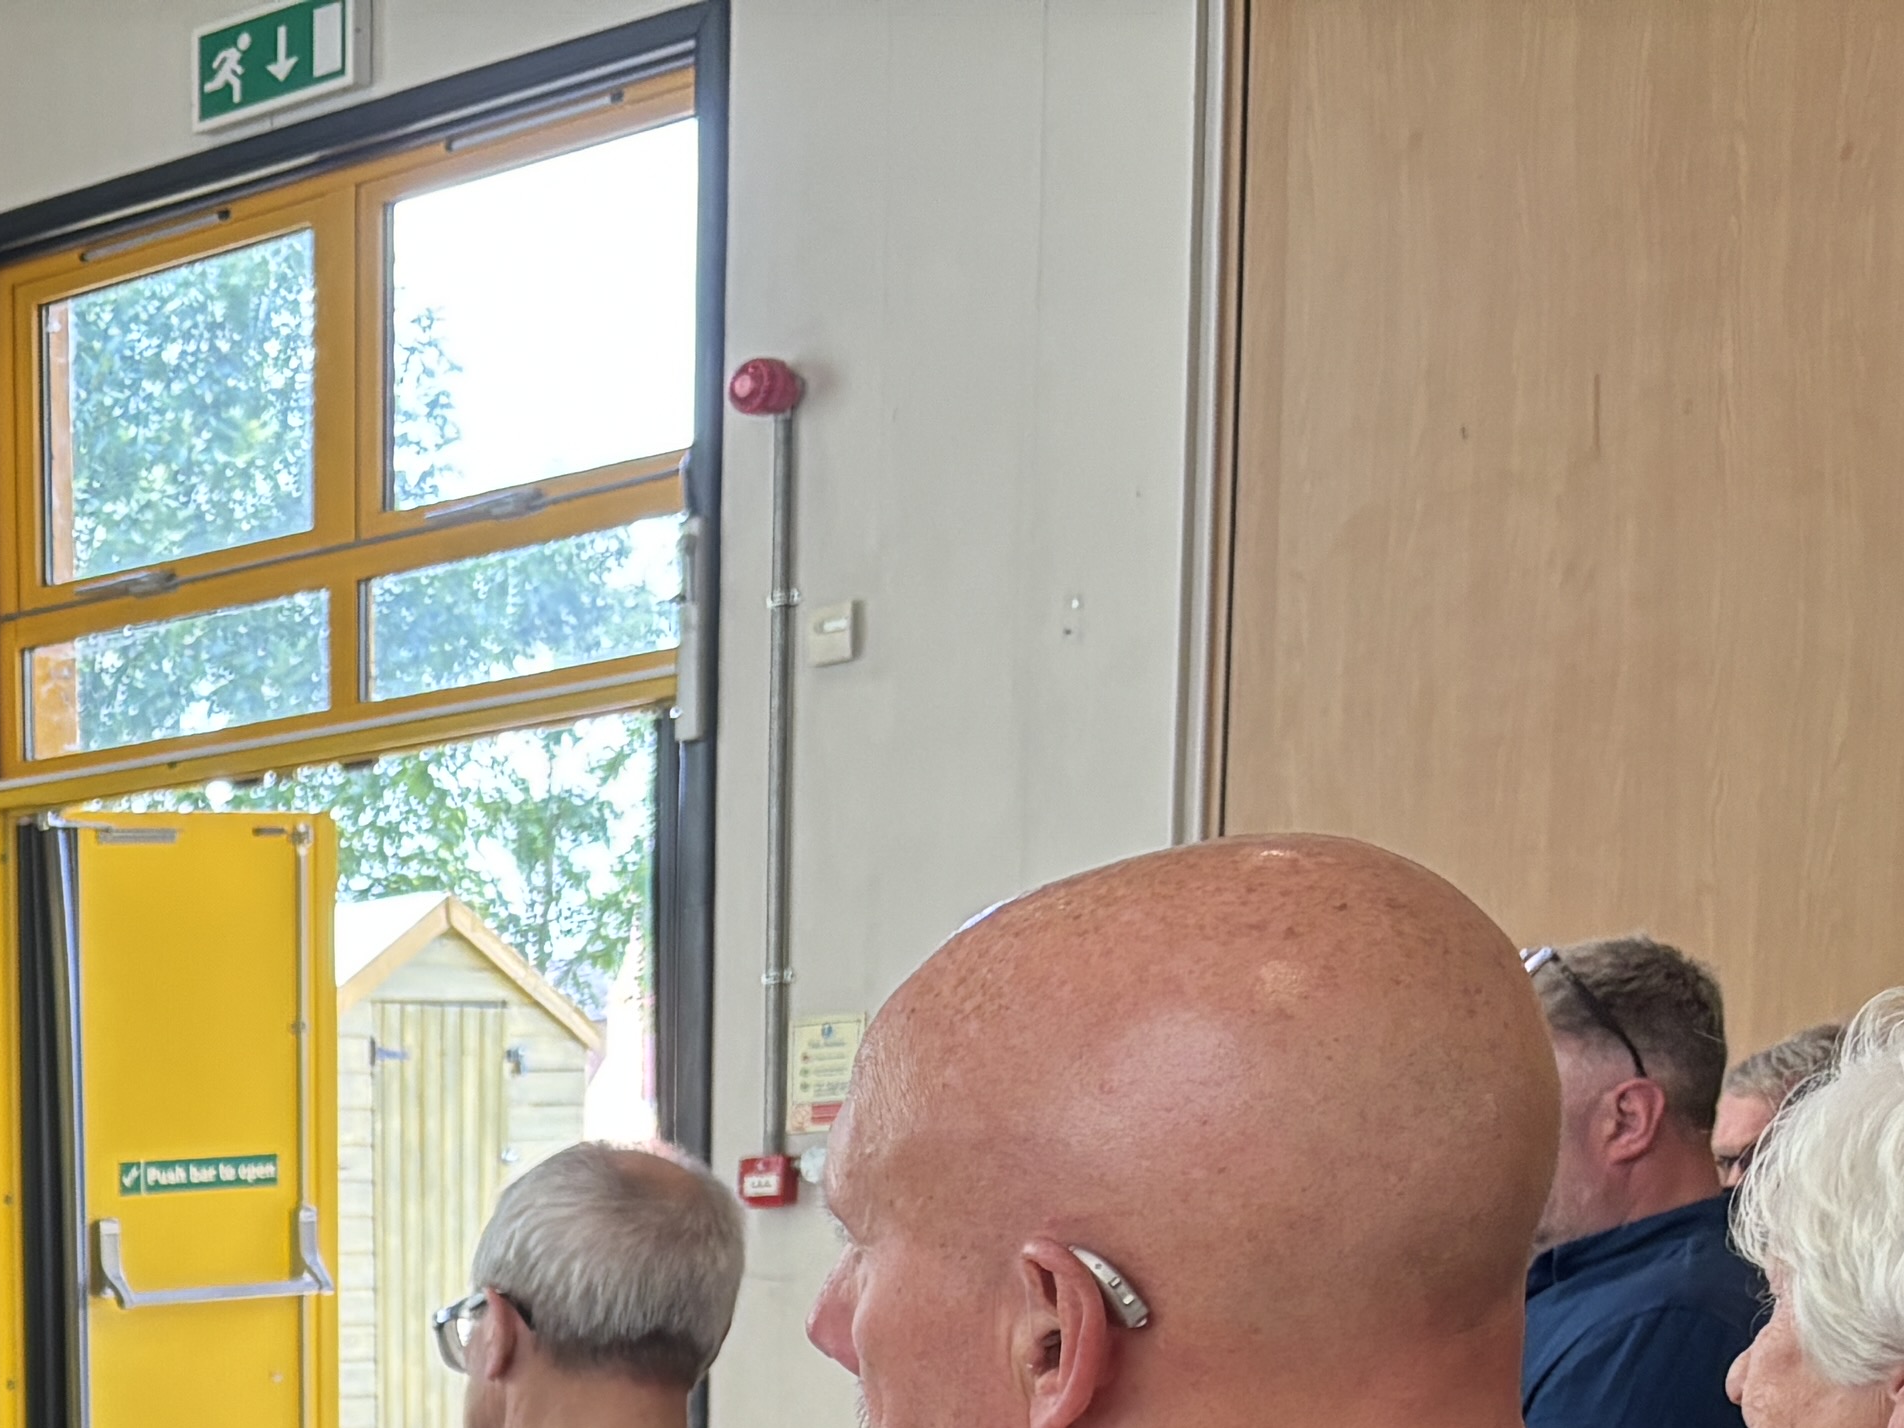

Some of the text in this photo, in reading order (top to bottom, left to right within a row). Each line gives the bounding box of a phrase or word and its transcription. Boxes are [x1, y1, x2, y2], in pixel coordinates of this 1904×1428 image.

[146, 1162, 275, 1185] Push bar to open
